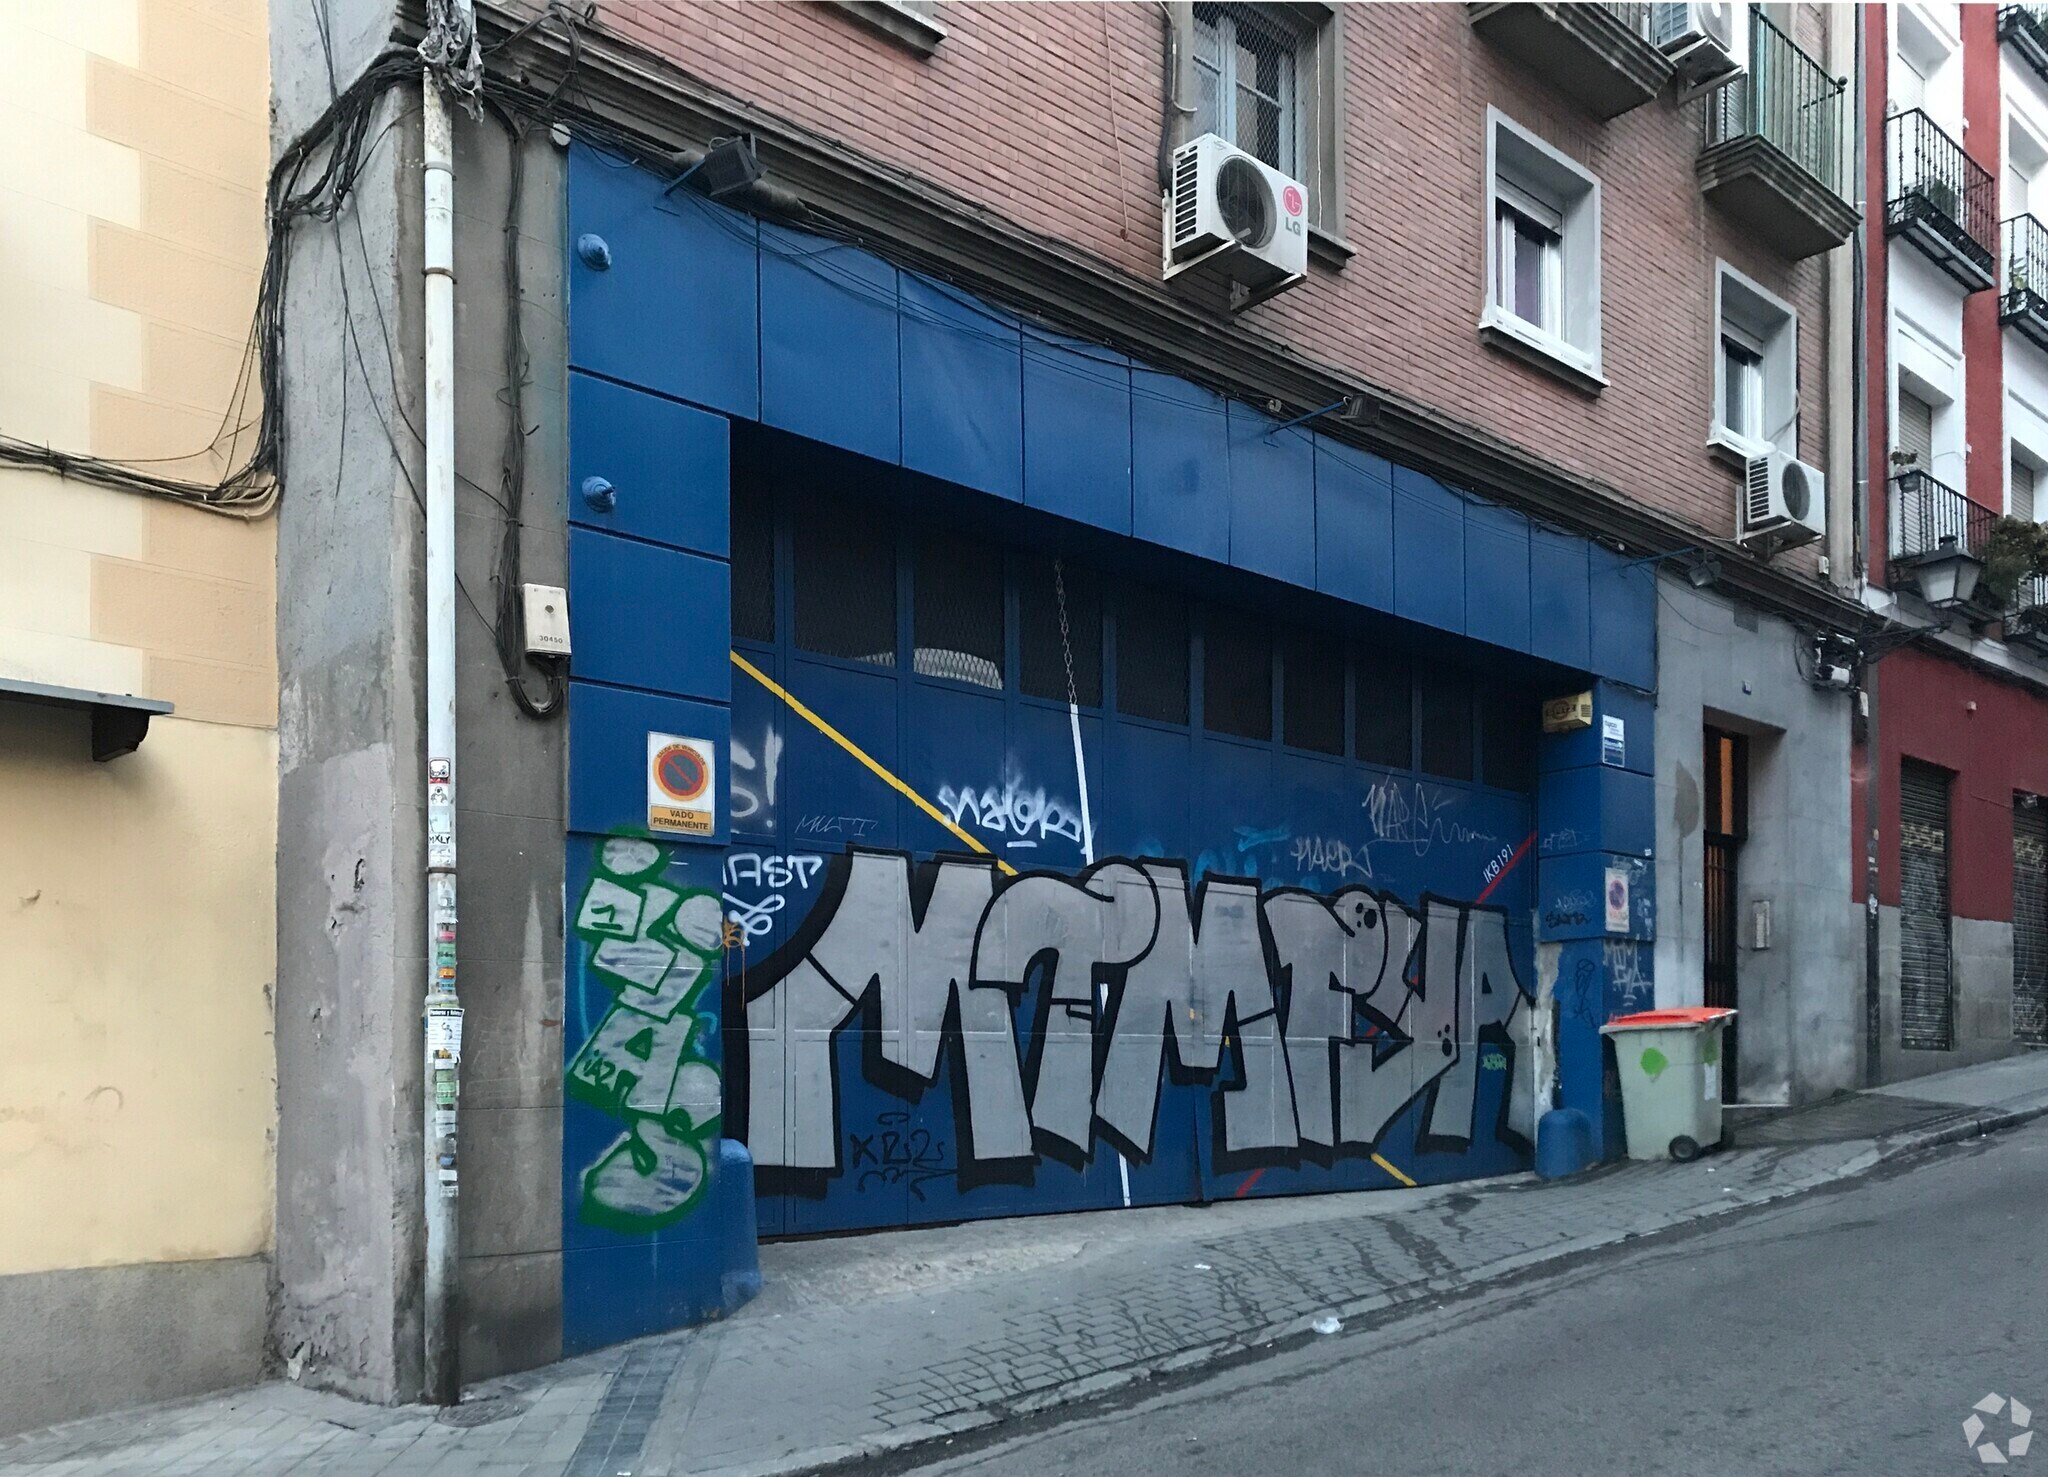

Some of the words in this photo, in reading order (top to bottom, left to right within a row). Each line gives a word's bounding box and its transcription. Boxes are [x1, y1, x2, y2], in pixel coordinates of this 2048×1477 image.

[1285, 216, 1302, 237] LG
[538, 634, 563, 644] 30450
[669, 809, 694, 819] VADO
[653, 816, 710, 830] PERMANENTE
